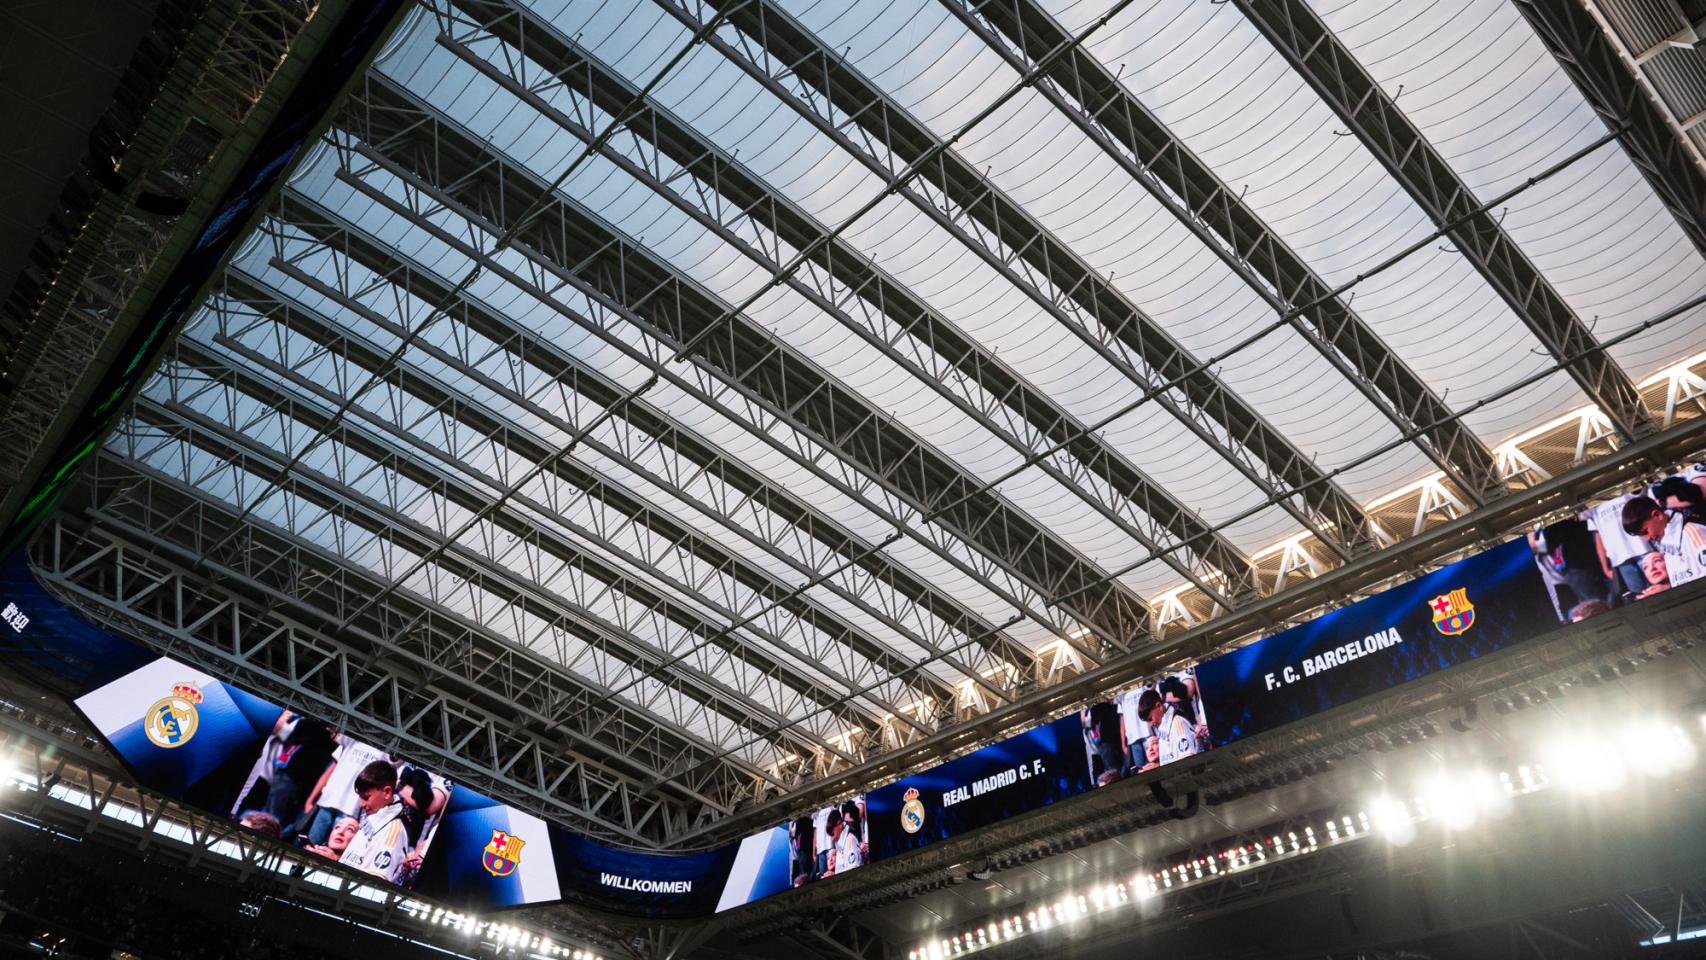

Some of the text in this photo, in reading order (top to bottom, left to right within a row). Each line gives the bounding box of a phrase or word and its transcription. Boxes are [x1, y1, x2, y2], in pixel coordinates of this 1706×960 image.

[1, 602, 29, 633] 歡迎
[1264, 627, 1403, 691] F. C. BARCELONA
[942, 759, 1046, 807] REAL MADRID C. F.
[374, 850, 392, 869] hp
[601, 872, 692, 894] WILLKOMMEN
